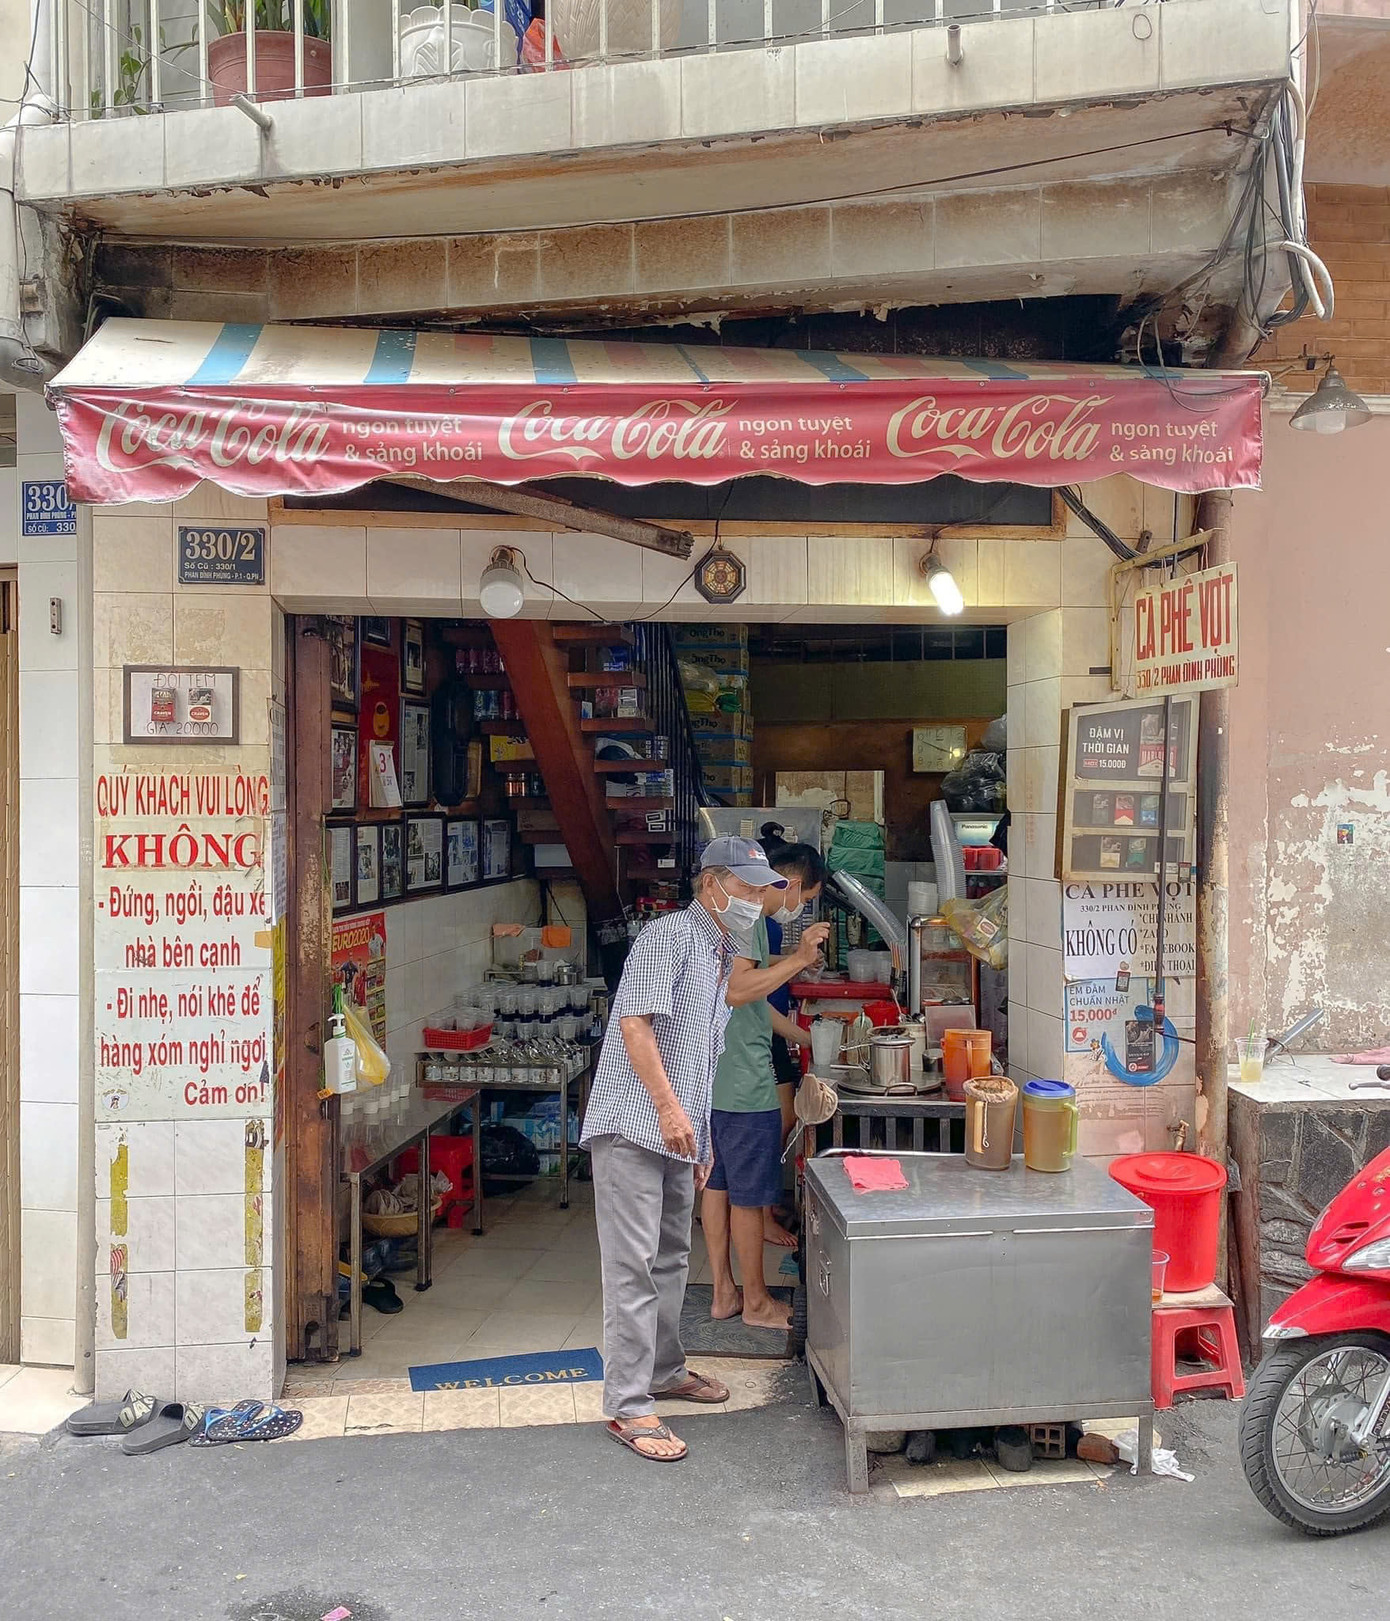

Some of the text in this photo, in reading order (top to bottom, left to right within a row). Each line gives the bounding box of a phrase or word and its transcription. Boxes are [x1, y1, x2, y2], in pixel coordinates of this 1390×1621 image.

[342, 415, 463, 437] ngon tuyệt
[498, 398, 738, 461] Coca-Cola
[739, 415, 853, 437] ngon tuyệt
[886, 394, 1115, 461] Coca-Cola
[1111, 418, 1218, 442] ngon tuyệt
[345, 442, 483, 467] & sảng khoái
[740, 438, 871, 464] & sảng khoái
[1110, 443, 1234, 466] & sảng khoái
[185, 531, 256, 560] 330/2
[215, 563, 236, 571] 330/1
[1136, 592, 1156, 661] CÀ
[1160, 578, 1194, 657] PHÊ
[1136, 653, 1235, 689] 330/2 PHAN ĐÌNH PHÙNG
[1082, 740, 1130, 754] THỜI GIAN
[1113, 728, 1124, 741] VỊ
[97, 765, 269, 817] QUÝ KHÁCH VUI LÒNG
[102, 824, 264, 869] KHÔNG
[110, 884, 160, 926] Đứng,
[166, 880, 207, 925] ngồi,
[213, 885, 244, 922] đậu
[1065, 881, 1096, 900] CÀ
[1080, 904, 1101, 913] 330/2
[1102, 903, 1126, 912] PHAN
[332, 926, 370, 952] EURO2020
[1066, 919, 1138, 957] KHÔNG CÓ
[125, 936, 241, 973] nhà bên cạnh
[117, 987, 133, 1019] Đi
[138, 987, 173, 1025] nhẹ,
[178, 984, 203, 1017] nói
[208, 984, 236, 1017] khẽ
[241, 973, 264, 1016] để
[100, 1034, 142, 1076] hàng
[148, 1033, 183, 1066] xóm
[189, 1028, 225, 1074] nghỉ
[184, 1079, 265, 1106] Cảm ơn!
[434, 1367, 589, 1391] WELCOME
